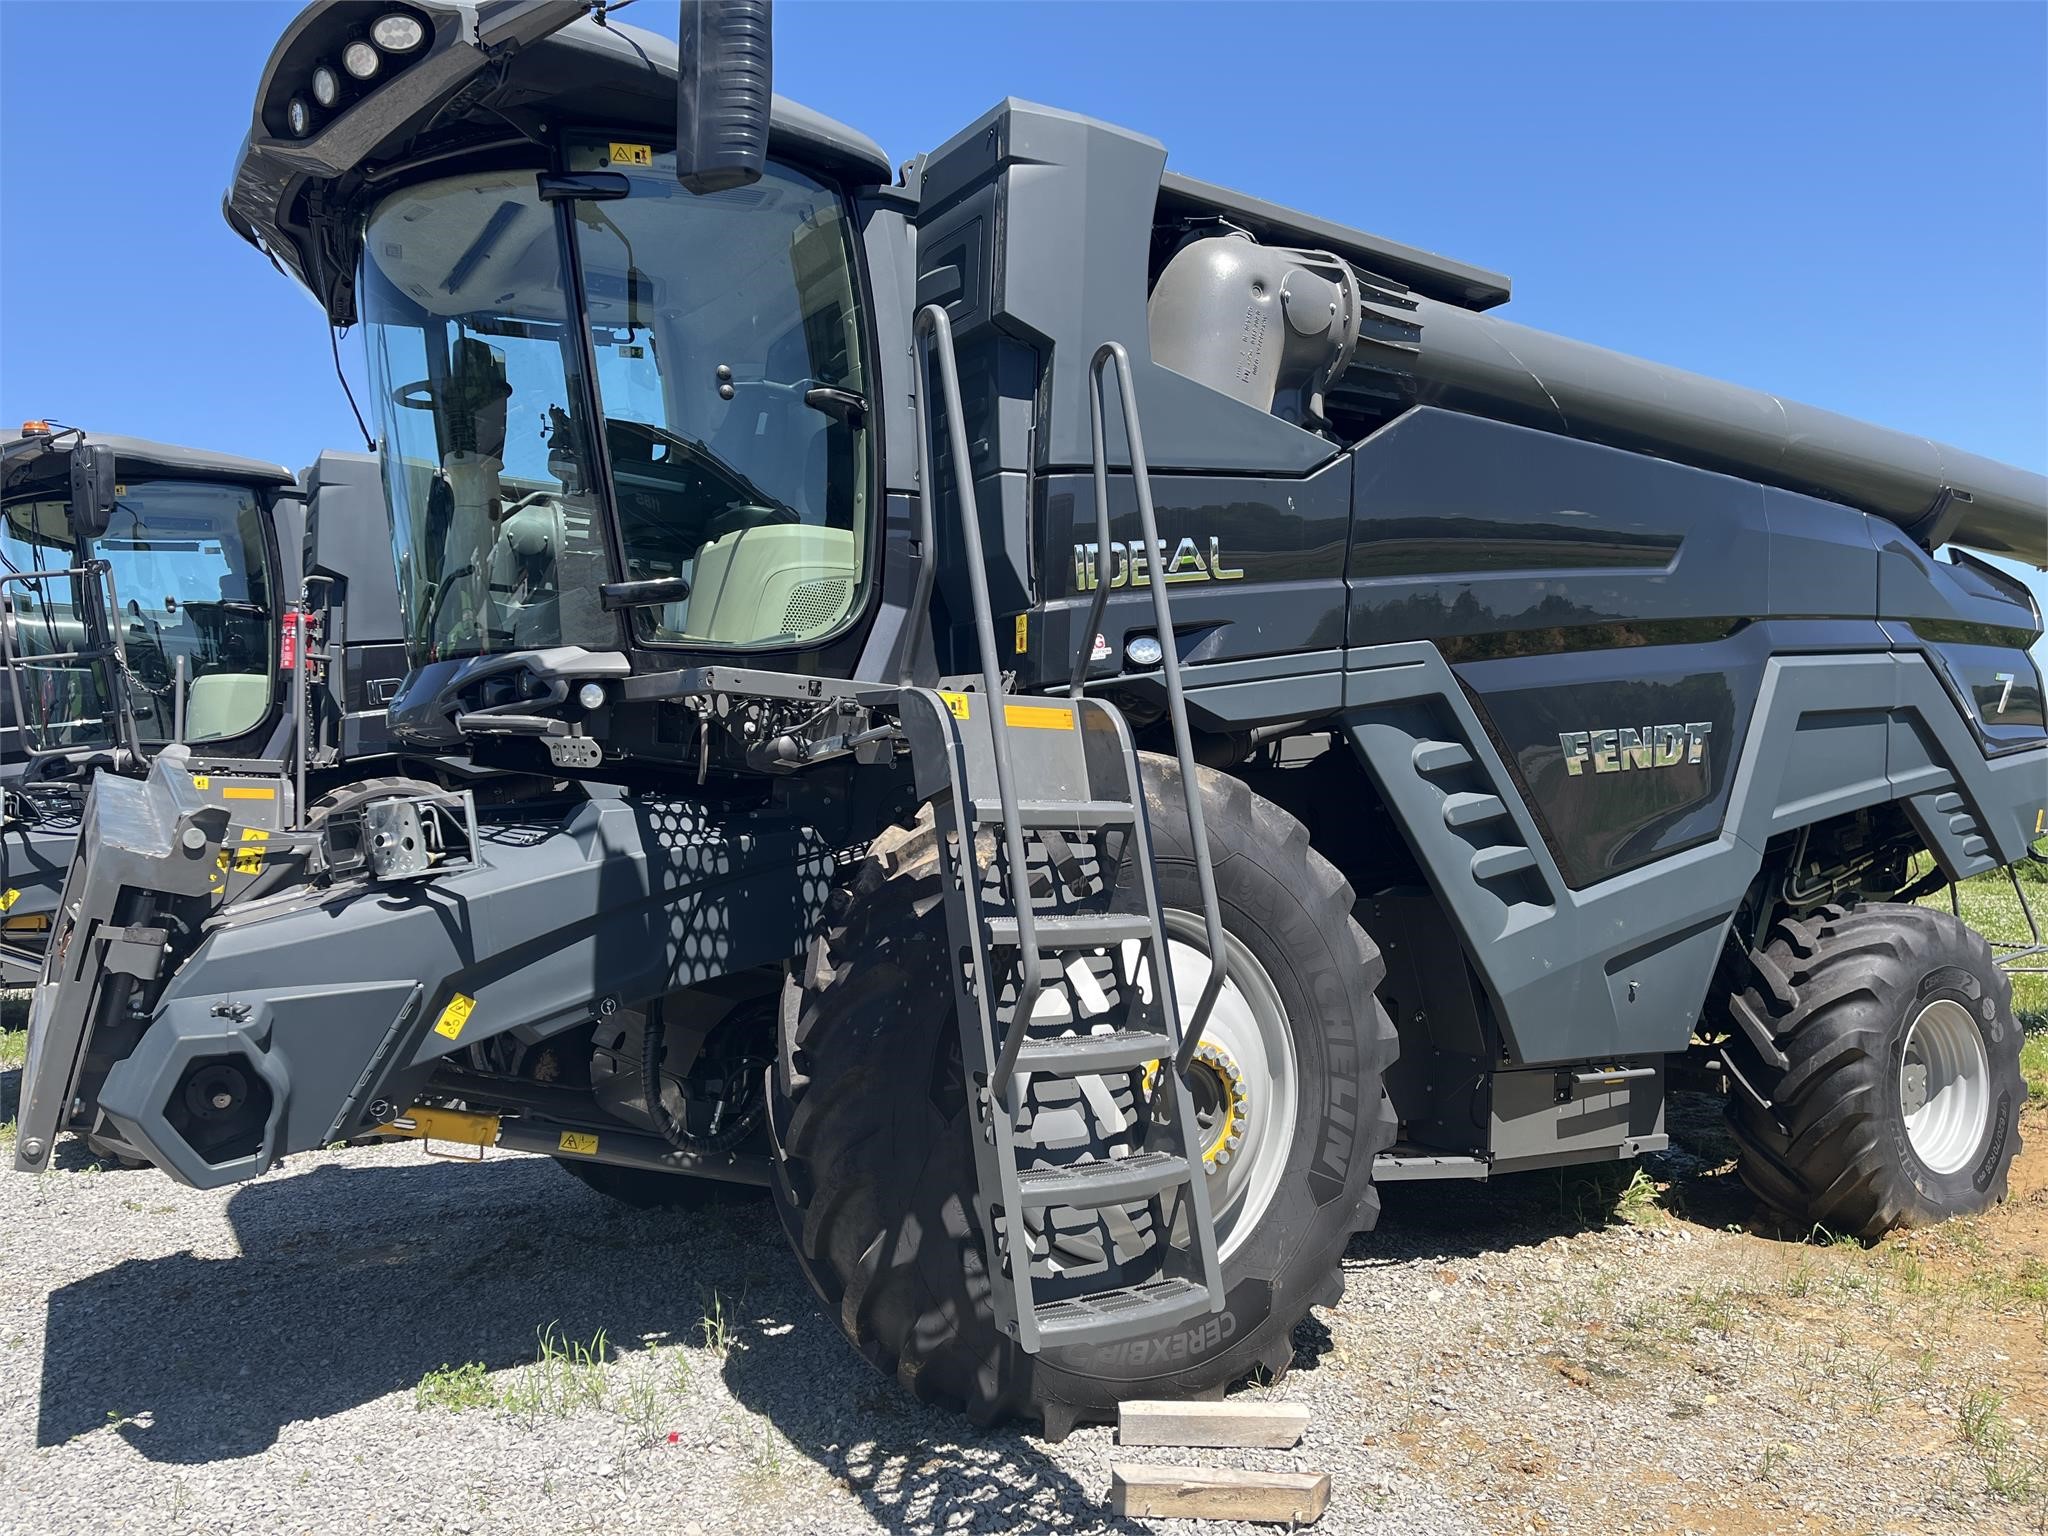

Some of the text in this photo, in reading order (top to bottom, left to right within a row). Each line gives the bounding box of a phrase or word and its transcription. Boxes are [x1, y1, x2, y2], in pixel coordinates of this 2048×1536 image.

[1074, 536, 1244, 591] IDEAL
[1995, 672, 2014, 714] 7
[1558, 721, 1713, 777] FENDT
